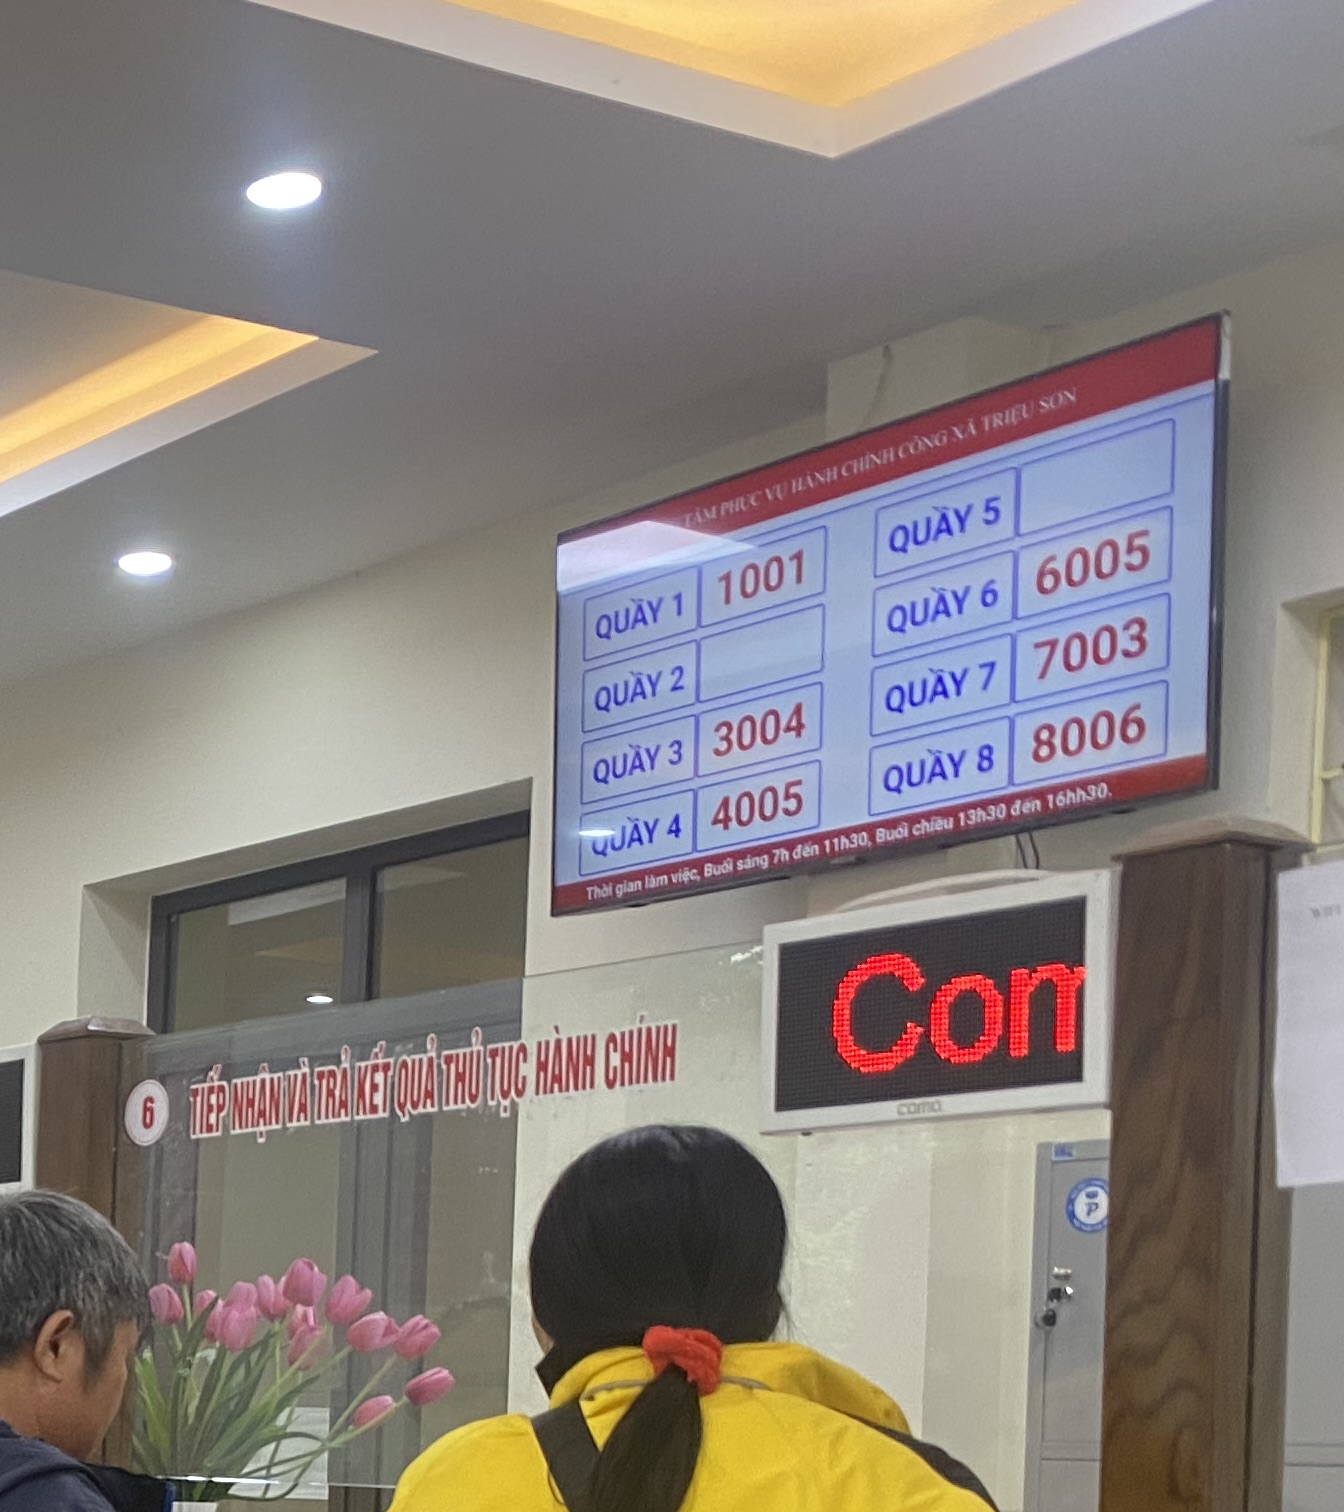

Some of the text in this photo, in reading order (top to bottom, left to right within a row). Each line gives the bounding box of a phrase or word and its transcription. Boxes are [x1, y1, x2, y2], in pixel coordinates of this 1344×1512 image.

[889, 496, 1001, 553] QUẦY 5
[596, 548, 804, 640] QUẦY 1 1001
[887, 529, 1150, 634] QUẦY 6 6005
[595, 665, 684, 712] QUẦY 2
[885, 616, 1148, 714] QUẦY 7 7003
[593, 702, 805, 785] QUẦY 3 3004
[883, 703, 1146, 794] QUẦY 8 8006
[616, 882, 643, 897] gian
[645, 873, 668, 889] làm
[772, 848, 789, 864] 7h
[958, 803, 1006, 827] 13h30
[667, 813, 682, 838] 4
[711, 779, 803, 831] 4005
[142, 1013, 678, 1143] 6 TIẾP NHẬN VÀ TRẢ KẾT QUẢ THỦ TỤC HÀNH CHÍNH
